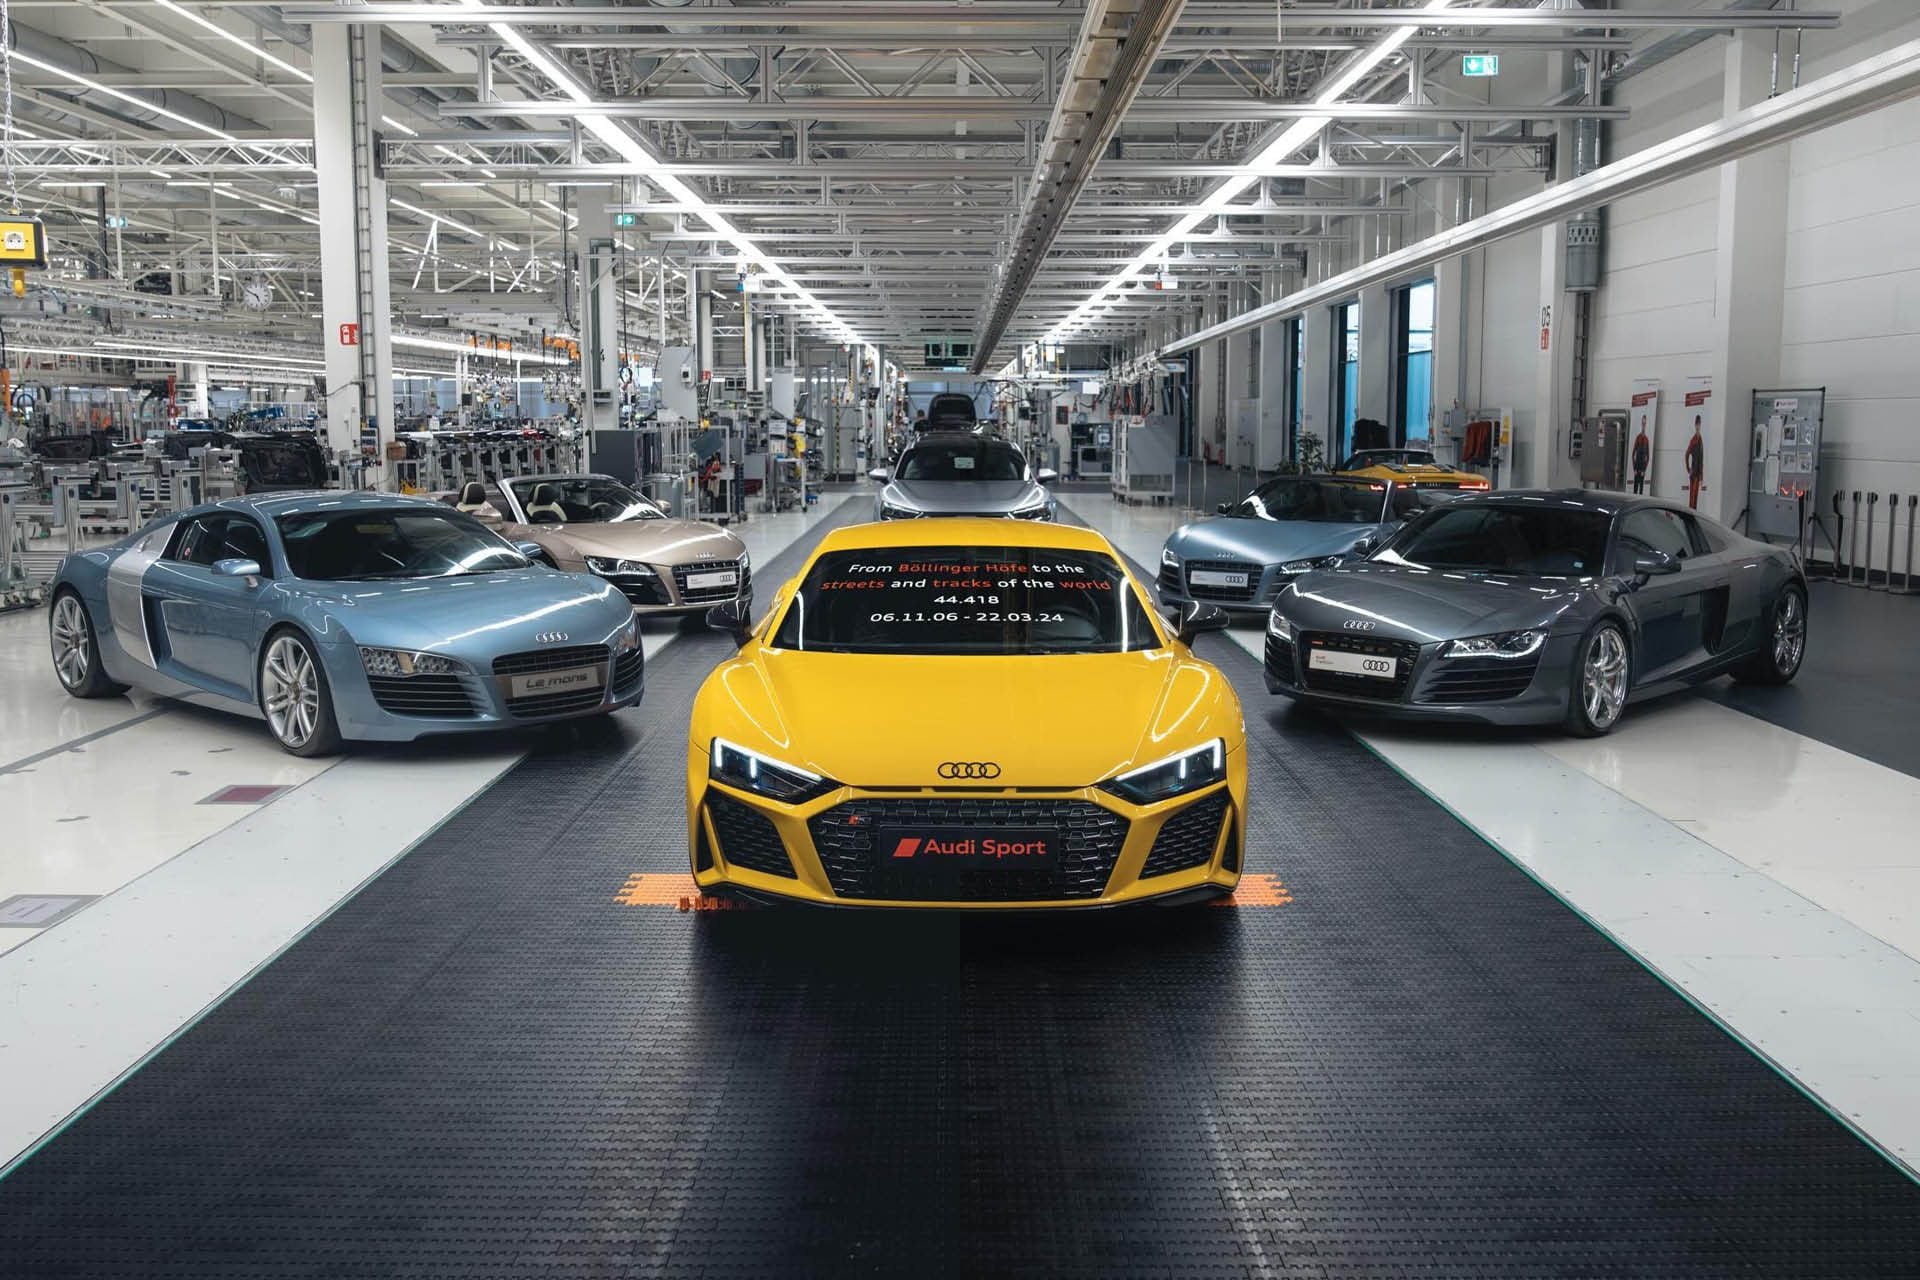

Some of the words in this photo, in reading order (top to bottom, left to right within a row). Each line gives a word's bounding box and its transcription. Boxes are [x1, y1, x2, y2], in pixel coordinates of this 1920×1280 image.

[848, 564, 893, 573] From
[898, 563, 979, 575] Böllinger
[985, 563, 1028, 573] Höfe
[1032, 564, 1051, 573] to
[1055, 564, 1085, 574] the
[821, 580, 885, 589] streets
[891, 579, 926, 588] and
[933, 579, 992, 588] tracks
[997, 578, 1018, 588] of
[1022, 578, 1055, 589] the
[1059, 580, 1112, 590] world
[934, 595, 1000, 604] 44.418
[870, 612, 959, 622] 06.11.06
[976, 612, 1065, 622] 22.03.24
[924, 839, 975, 855] Audi
[982, 840, 1046, 859] Sport
